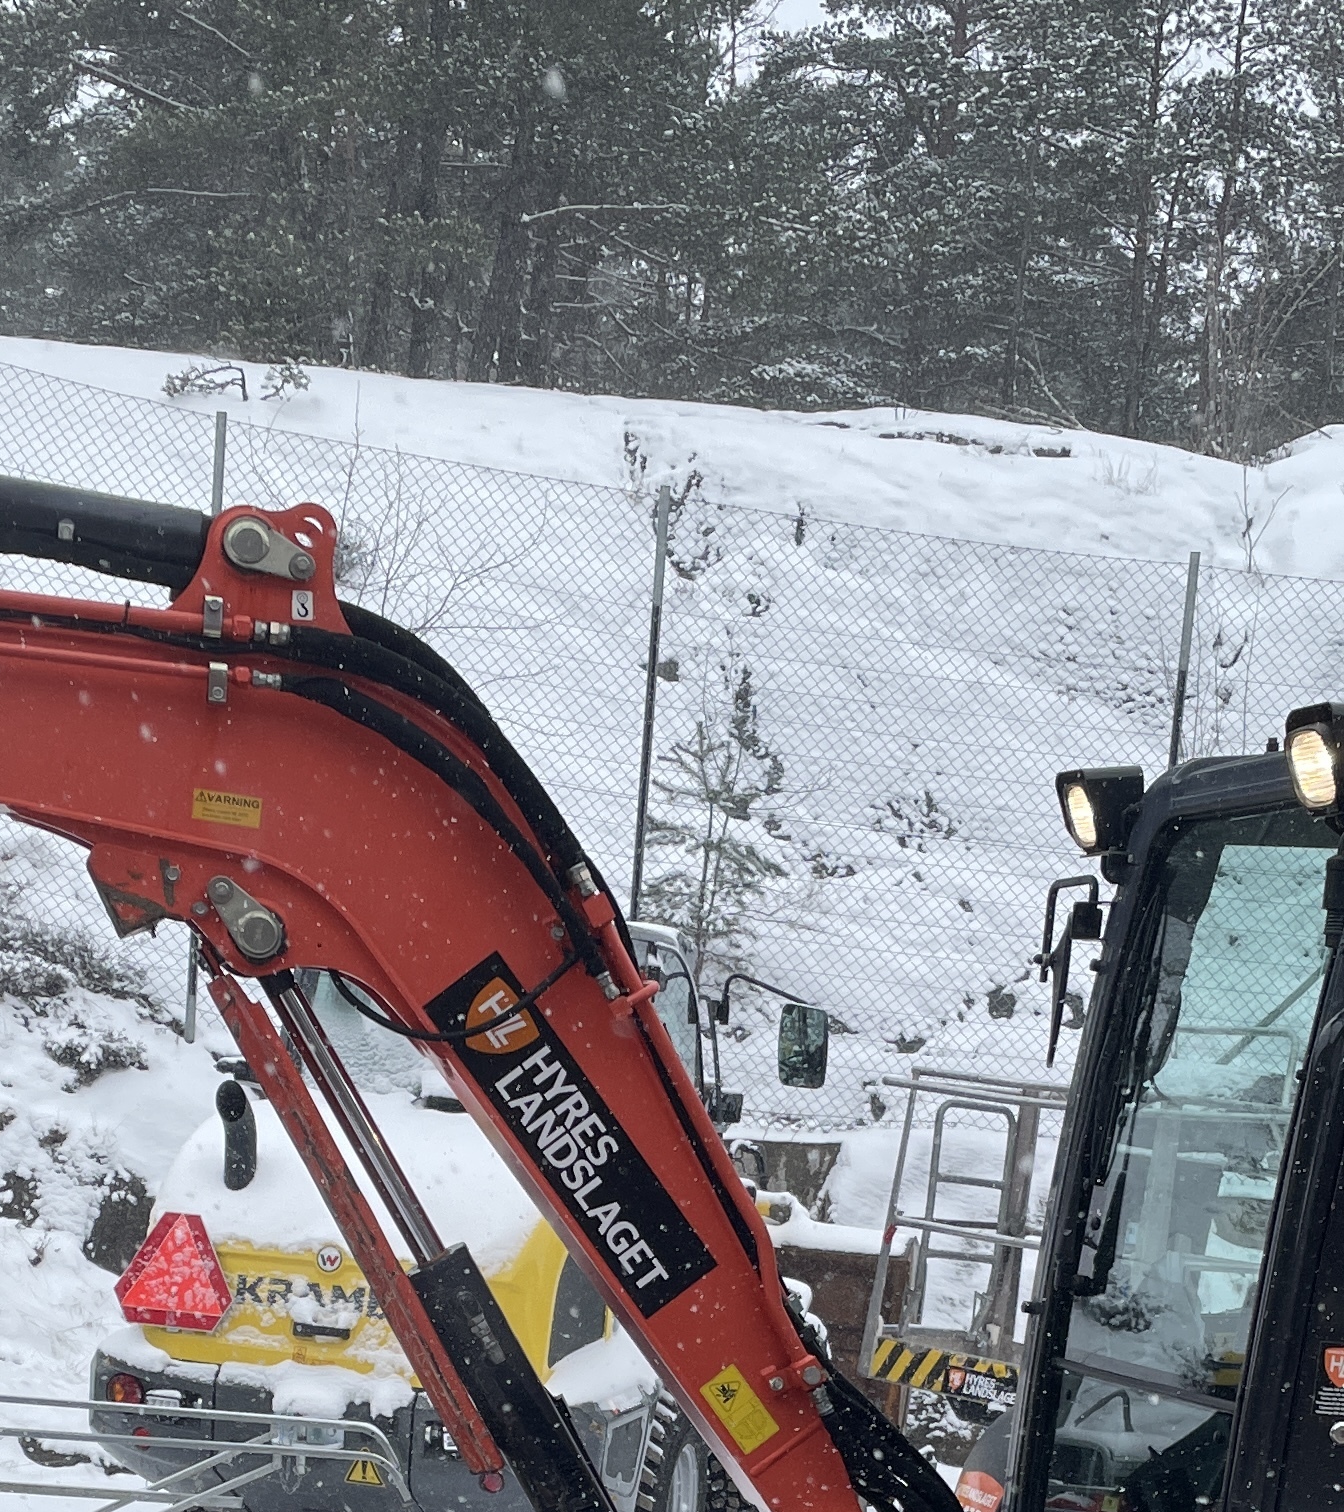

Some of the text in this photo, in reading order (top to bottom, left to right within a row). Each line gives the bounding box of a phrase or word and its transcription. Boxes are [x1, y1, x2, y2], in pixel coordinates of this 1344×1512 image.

[207, 794, 260, 809] VARNING
[521, 1044, 619, 1167] HYRES
[494, 1064, 669, 1290] LANDSLAGET
[966, 1373, 996, 1389] HYRES
